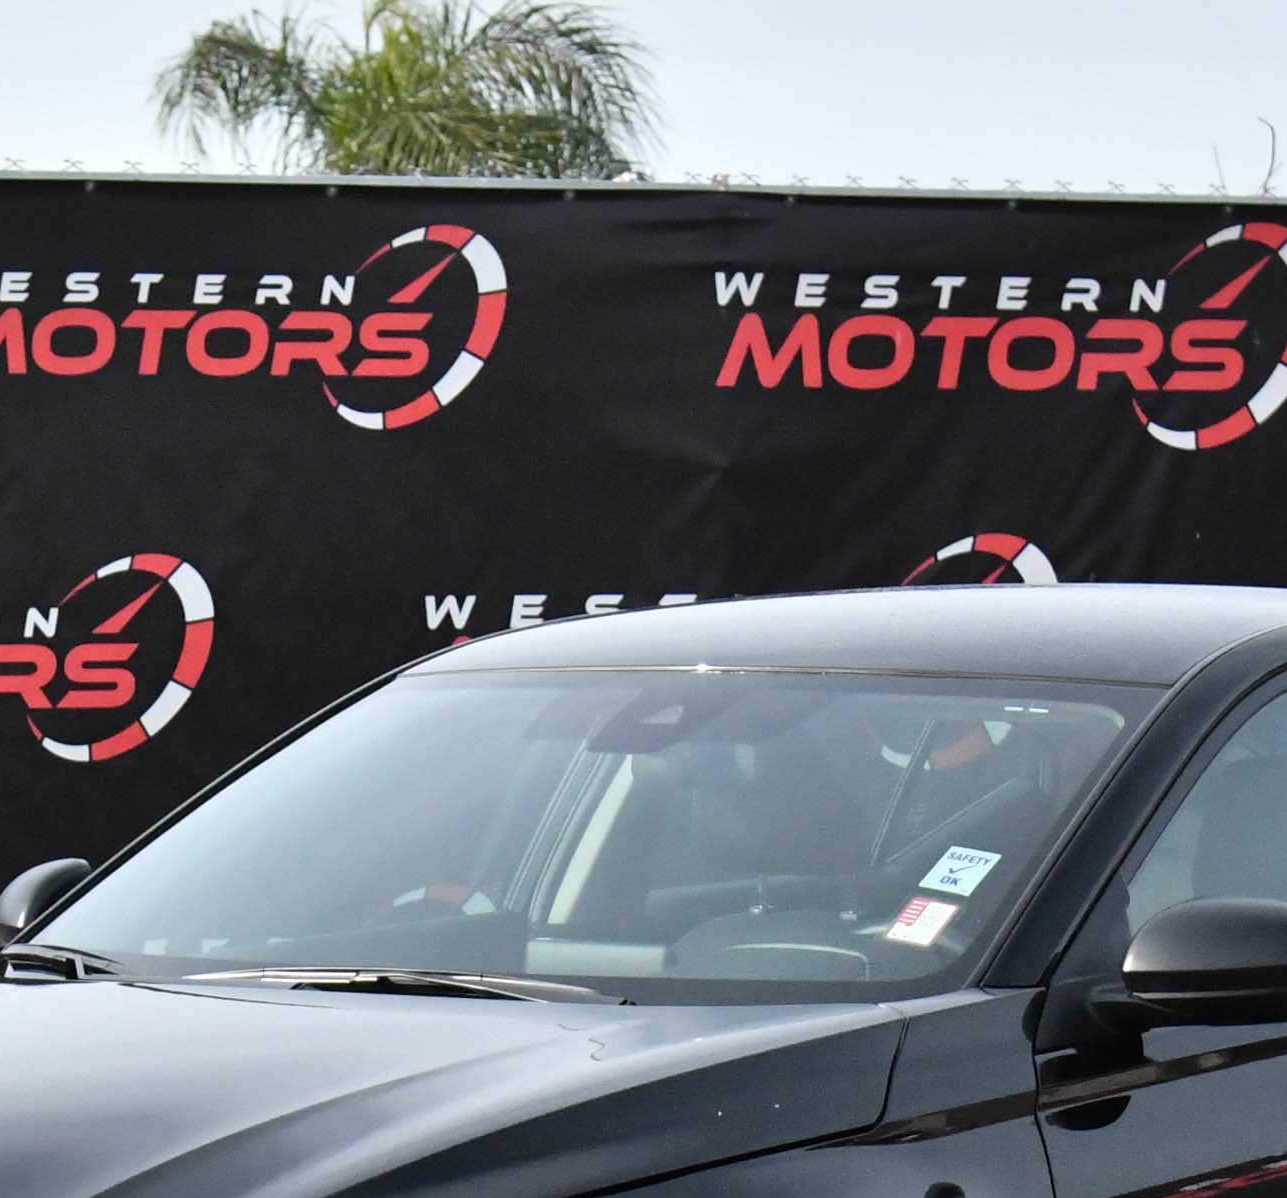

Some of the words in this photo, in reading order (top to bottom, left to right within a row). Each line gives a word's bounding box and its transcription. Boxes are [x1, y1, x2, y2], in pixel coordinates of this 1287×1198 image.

[715, 271, 1166, 313] WESTERN
[717, 313, 1246, 390] MOTORS
[947, 852, 992, 866] SAFETY
[939, 875, 962, 886] OK
